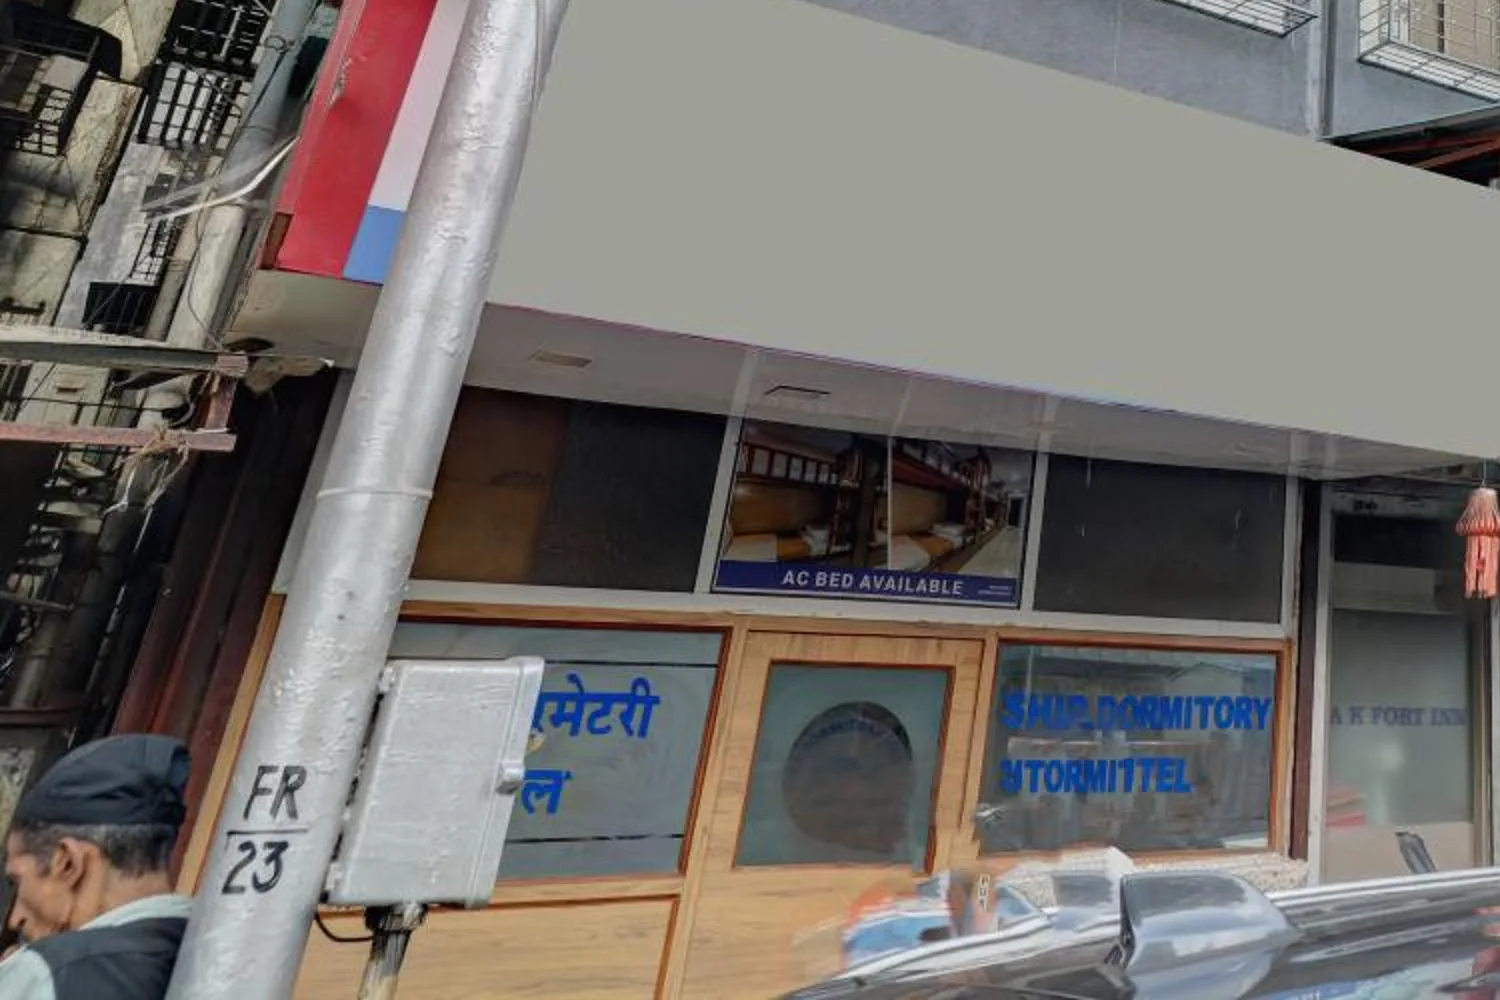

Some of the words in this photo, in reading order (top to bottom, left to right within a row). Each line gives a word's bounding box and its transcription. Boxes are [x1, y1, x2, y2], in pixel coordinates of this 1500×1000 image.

[782, 570, 809, 586] AC
[815, 572, 854, 587] BED
[859, 575, 964, 595] AVAILABLE
[243, 765, 307, 820] FR
[222, 841, 289, 894] 23
